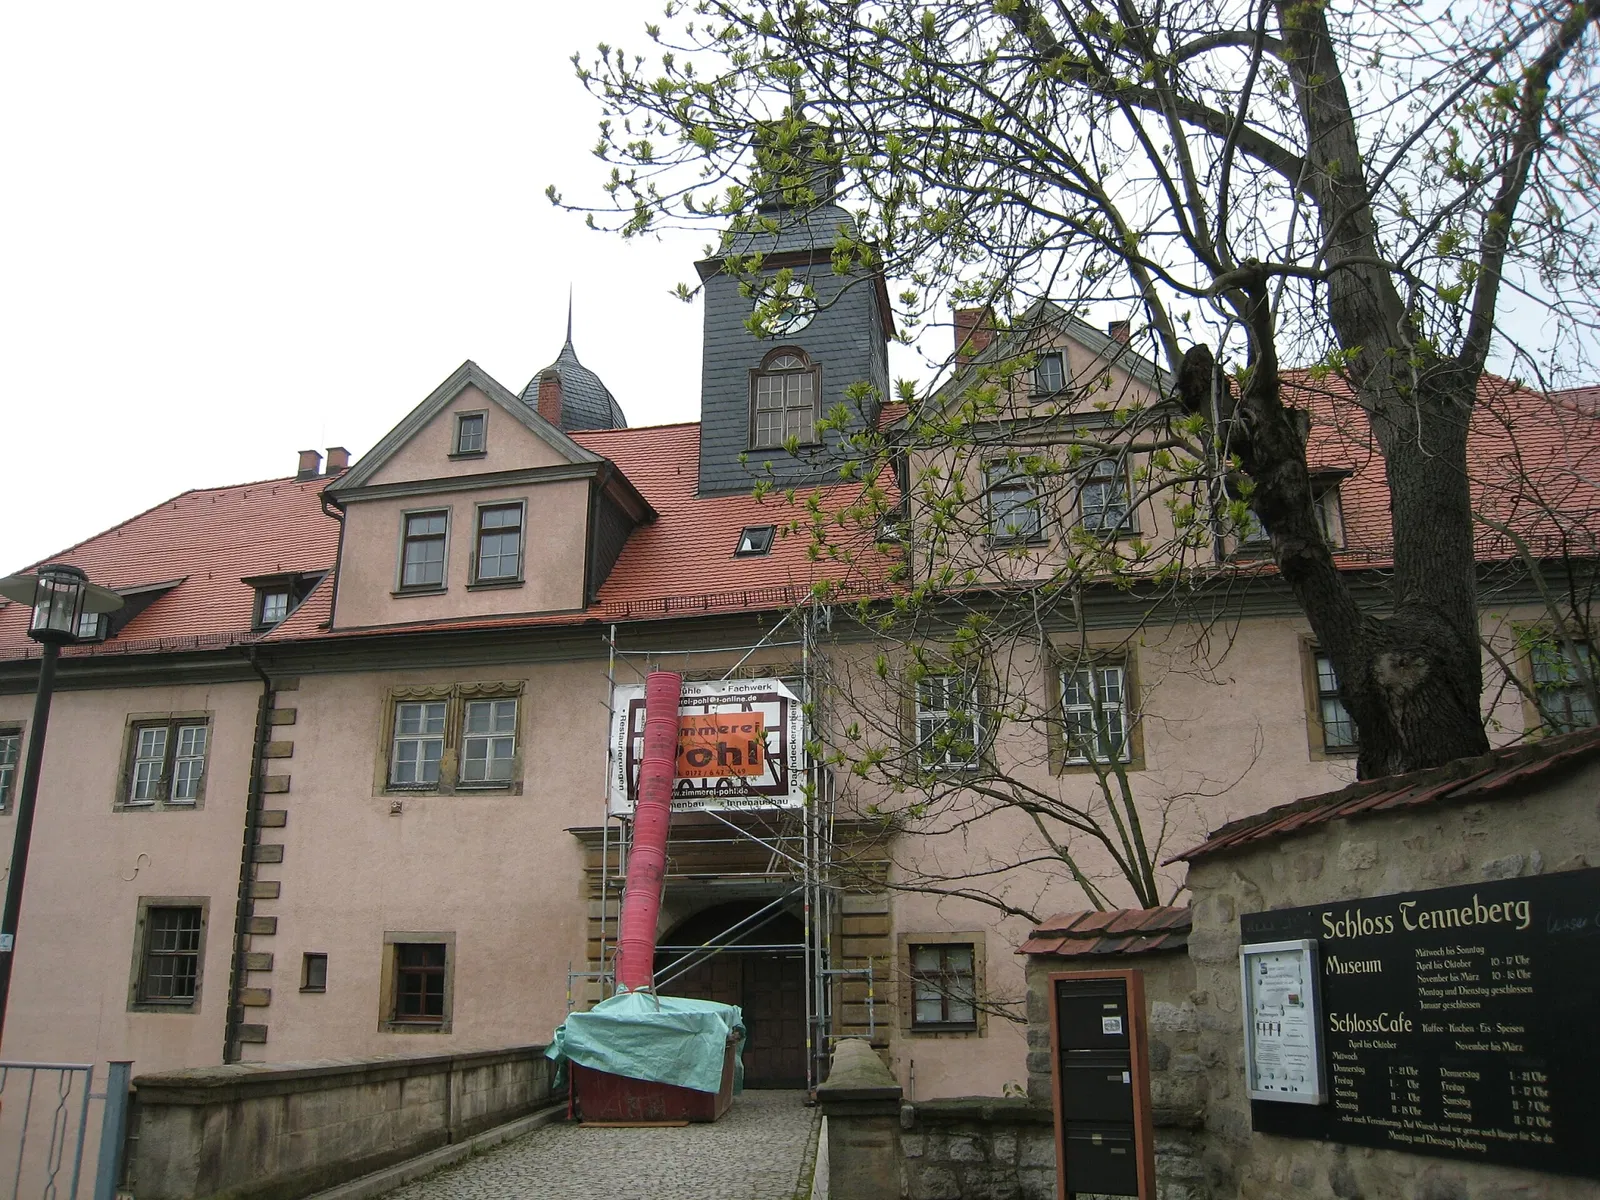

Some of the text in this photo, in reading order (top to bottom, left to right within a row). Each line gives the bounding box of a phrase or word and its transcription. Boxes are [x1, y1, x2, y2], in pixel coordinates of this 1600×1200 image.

[682, 683, 772, 695] ühle Fachwerk
[680, 722, 760, 737] mmerei
[789, 700, 798, 787] Dachdeckerarbeite
[618, 715, 626, 791] Restaurierungen
[672, 788, 748, 796] w.zimmerei-pohl.de
[1322, 908, 1394, 940] Schloss
[1399, 894, 1531, 931] Tenneberg
[1415, 945, 1485, 958] Mittwoch bis Sonntag
[1326, 956, 1382, 976] Museum
[1416, 961, 1432, 971] April
[1434, 960, 1443, 970] bis
[1444, 959, 1472, 969] Oktober
[1514, 955, 1530, 966] Uhr
[1417, 974, 1448, 983] November
[1450, 972, 1459, 981] bis
[1516, 969, 1532, 980] Uhr
[1418, 984, 1533, 998] Montag und Dienstag geschlossen
[1420, 1000, 1481, 1011] Januar geschlossen
[1330, 1011, 1413, 1034] SchlossCafe
[1422, 1022, 1524, 1034] Kaffee Kuchen Eis Speisen
[1348, 1039, 1398, 1049] April bis Oktober
[1455, 1040, 1489, 1051] November
[1490, 1041, 1501, 1051] bis
[1332, 1063, 1366, 1075] Donnerstag
[1440, 1067, 1480, 1081] Donnerstag
[1334, 1075, 1354, 1087] Freitag
[1440, 1080, 1465, 1094] Freitag
[1335, 1087, 1358, 1100] Samstag
[1335, 1100, 1359, 1112] Sonntag
[1442, 1094, 1472, 1108] Samstag
[1443, 1108, 1472, 1122] Sonntag
[1388, 1130, 1413, 1144] Montag
[1413, 1134, 1425, 1142] und
[1426, 1134, 1456, 1149] Dienstag
